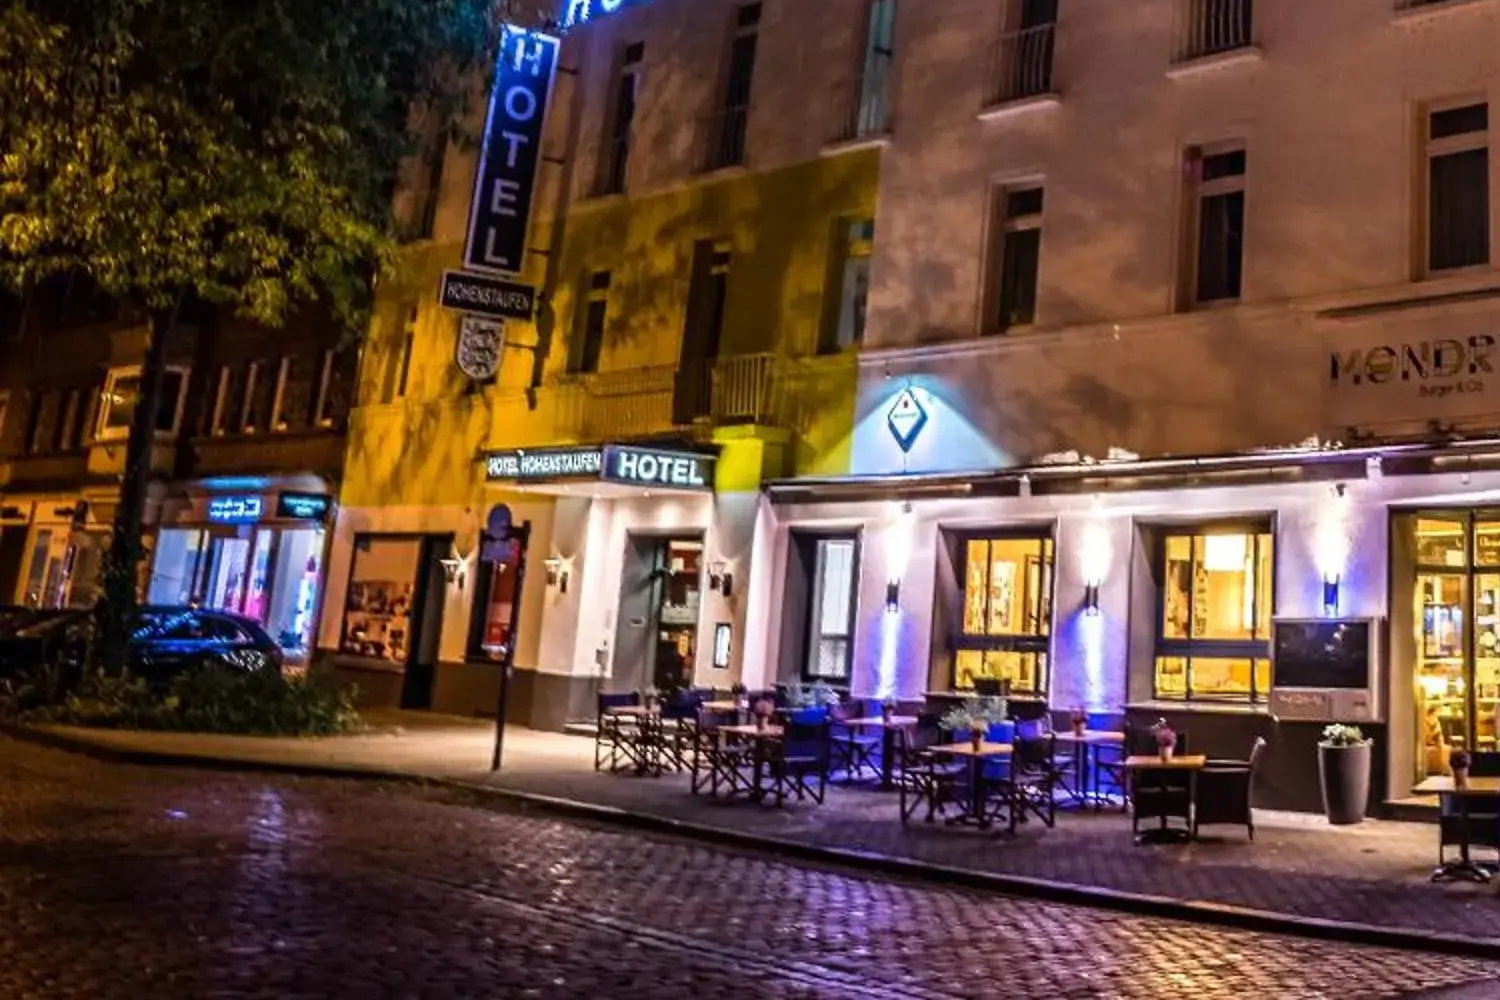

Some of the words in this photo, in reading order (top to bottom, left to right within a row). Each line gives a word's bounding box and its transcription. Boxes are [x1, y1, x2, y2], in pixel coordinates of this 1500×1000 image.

[484, 36, 543, 265] HOTEL
[489, 456, 519, 477] HOTEL
[520, 452, 601, 474] HOHENSTAUFEN
[618, 451, 704, 485] HOTEL
